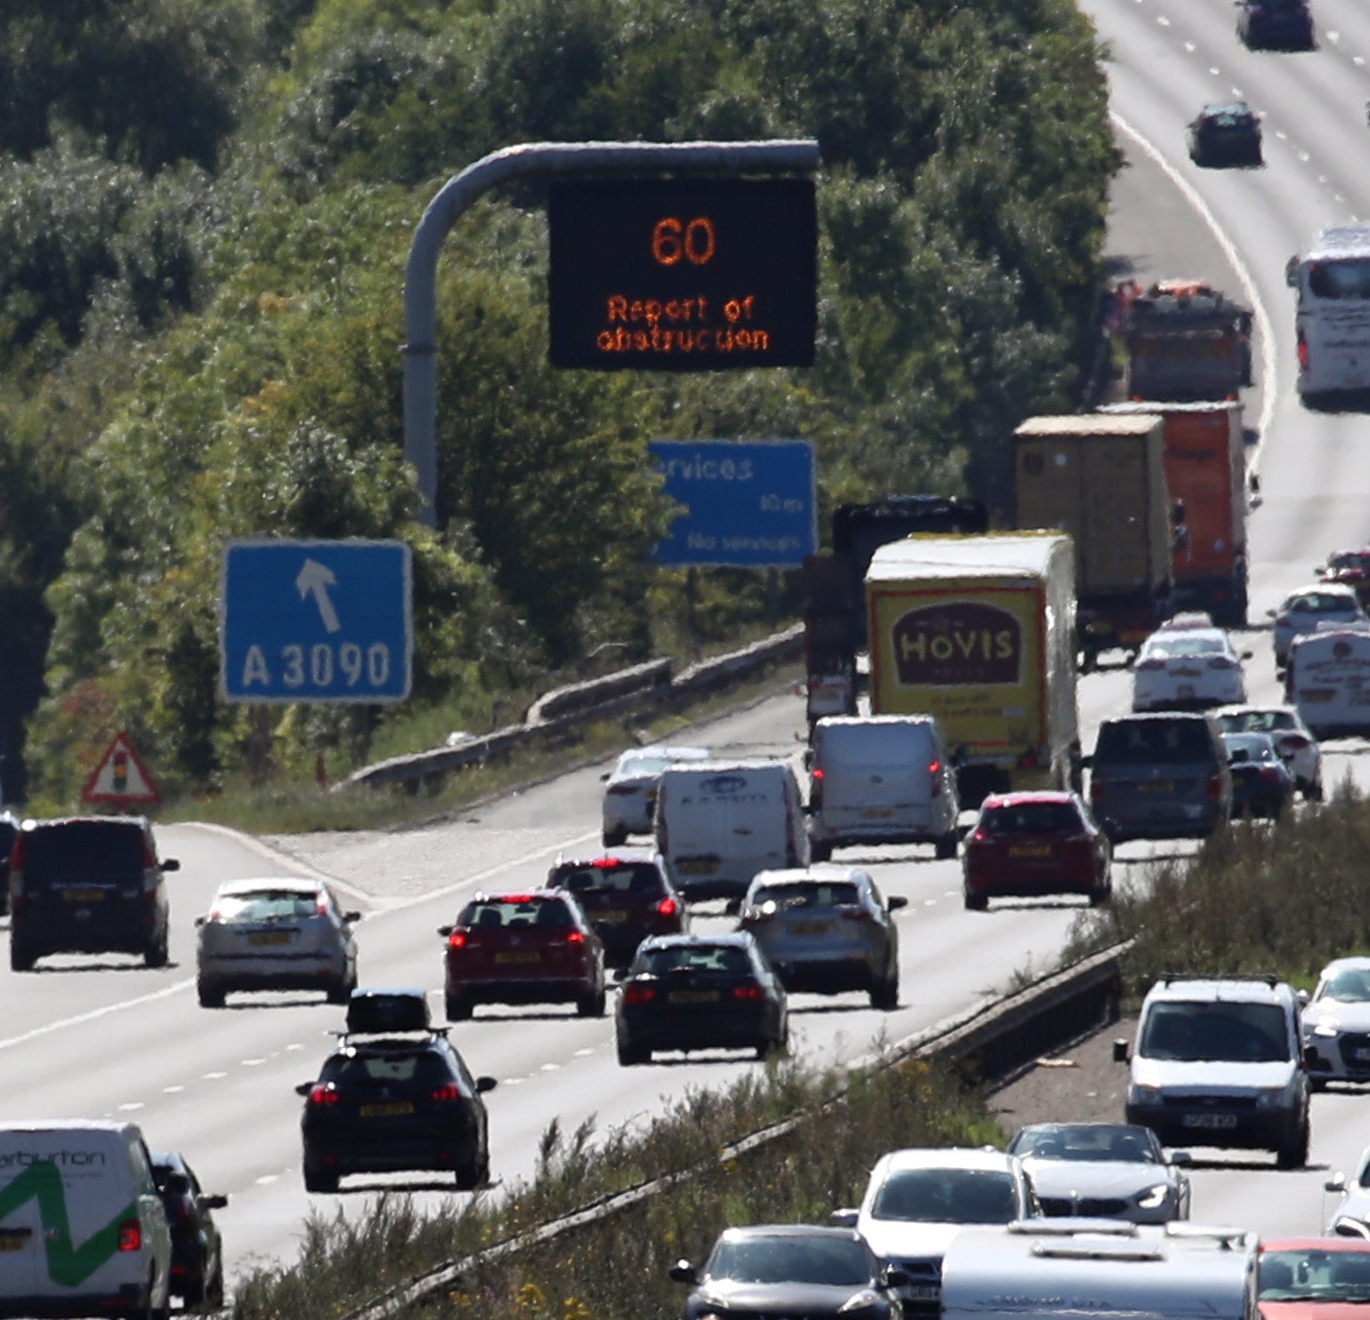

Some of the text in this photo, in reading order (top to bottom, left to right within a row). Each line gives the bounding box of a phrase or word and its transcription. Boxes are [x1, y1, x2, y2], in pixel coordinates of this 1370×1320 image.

[651, 217, 716, 266] 60
[607, 294, 755, 326] Report of
[596, 325, 770, 352] obstruction
[900, 630, 1014, 662] HOVIS
[242, 641, 391, 688] A 3090
